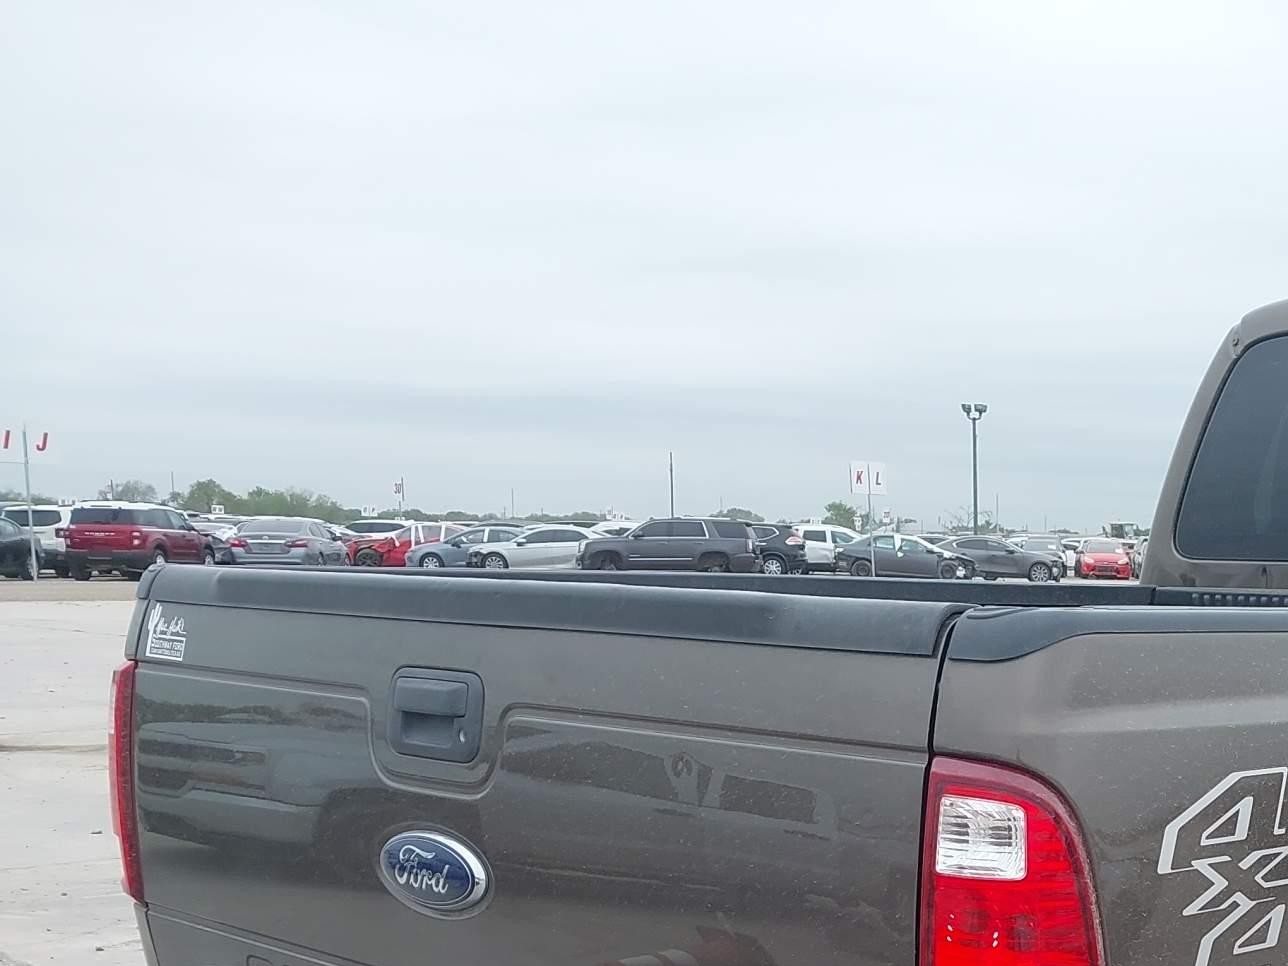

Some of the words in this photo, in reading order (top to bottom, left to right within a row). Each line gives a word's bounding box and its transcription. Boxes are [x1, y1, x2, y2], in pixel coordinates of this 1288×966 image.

[36, 432, 48, 451] J
[856, 470, 863, 485] K
[875, 471, 881, 485] L
[394, 844, 450, 894] Ford
